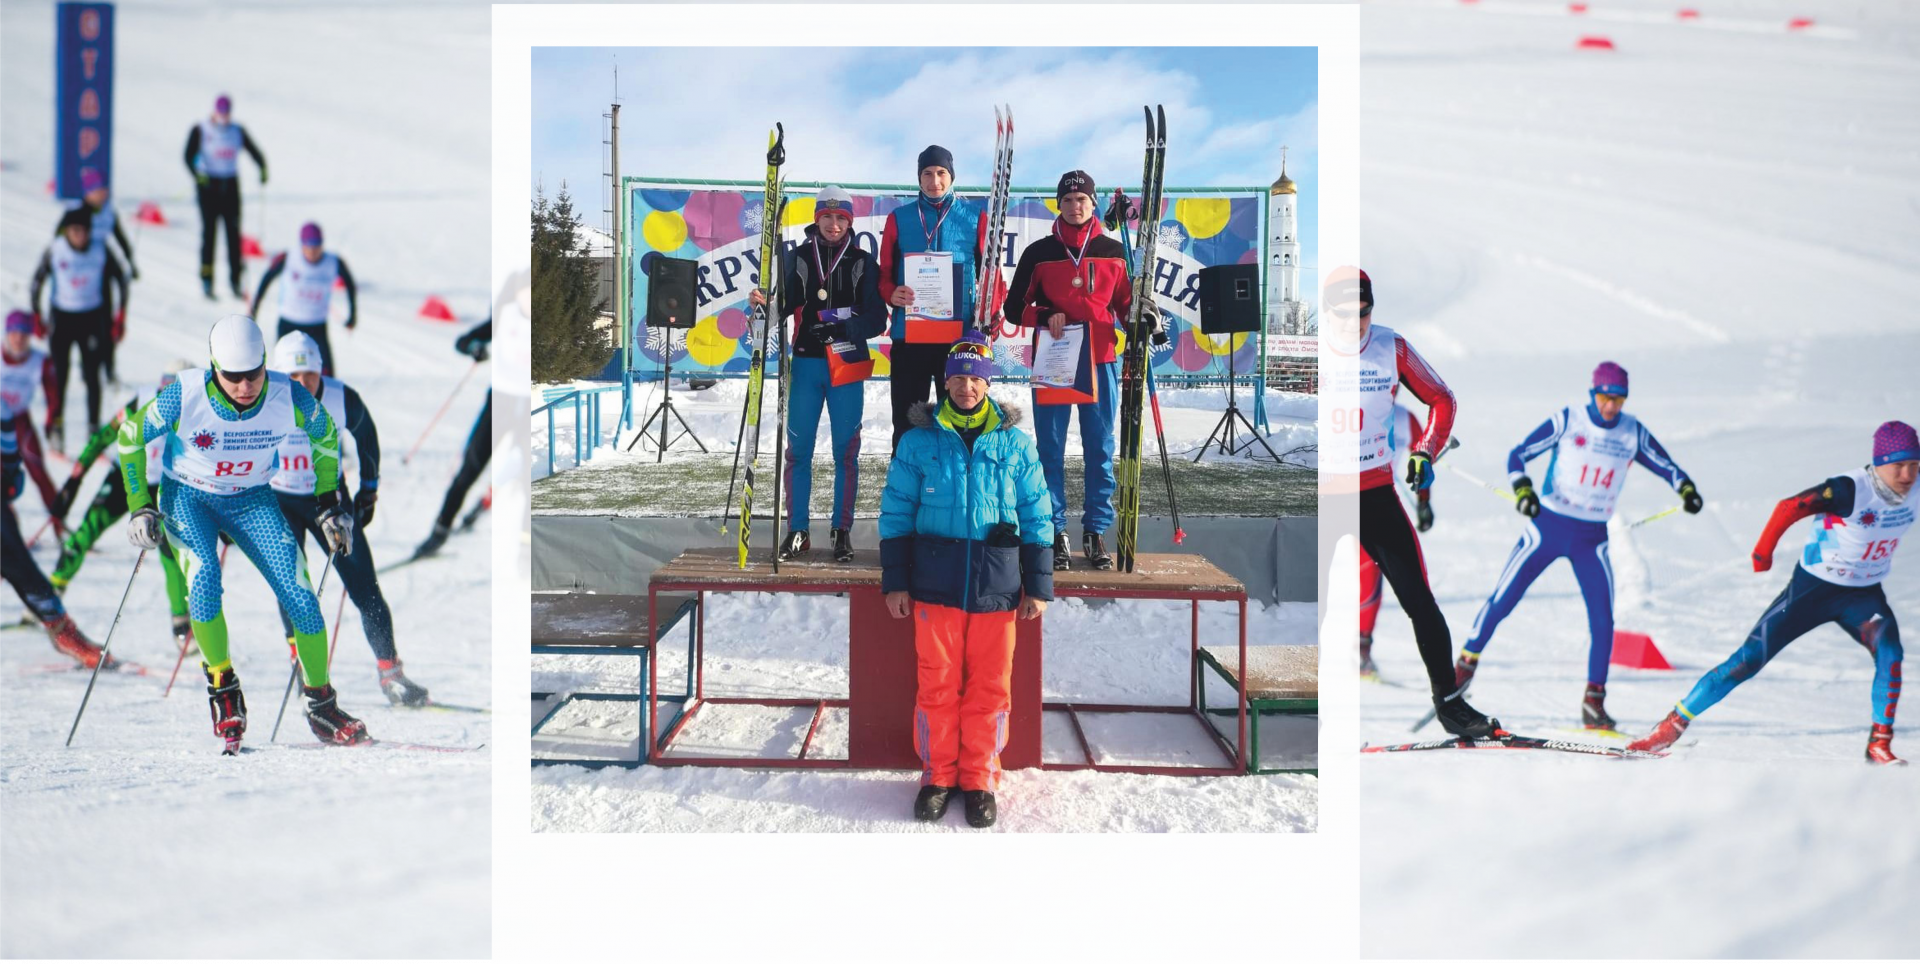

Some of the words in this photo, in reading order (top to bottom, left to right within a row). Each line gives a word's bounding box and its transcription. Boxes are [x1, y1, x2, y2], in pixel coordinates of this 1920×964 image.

[1064, 177, 1085, 186] DNB
[763, 180, 776, 248] FISCHER
[995, 148, 1013, 268] MADSHUS
[954, 352, 982, 361] LUKOIL
[1331, 407, 1364, 434] 90
[224, 429, 273, 437] ВСЕРОССИЙСКИЕ
[215, 460, 254, 477] 82
[280, 454, 315, 471] 10
[1580, 464, 1614, 489] 114
